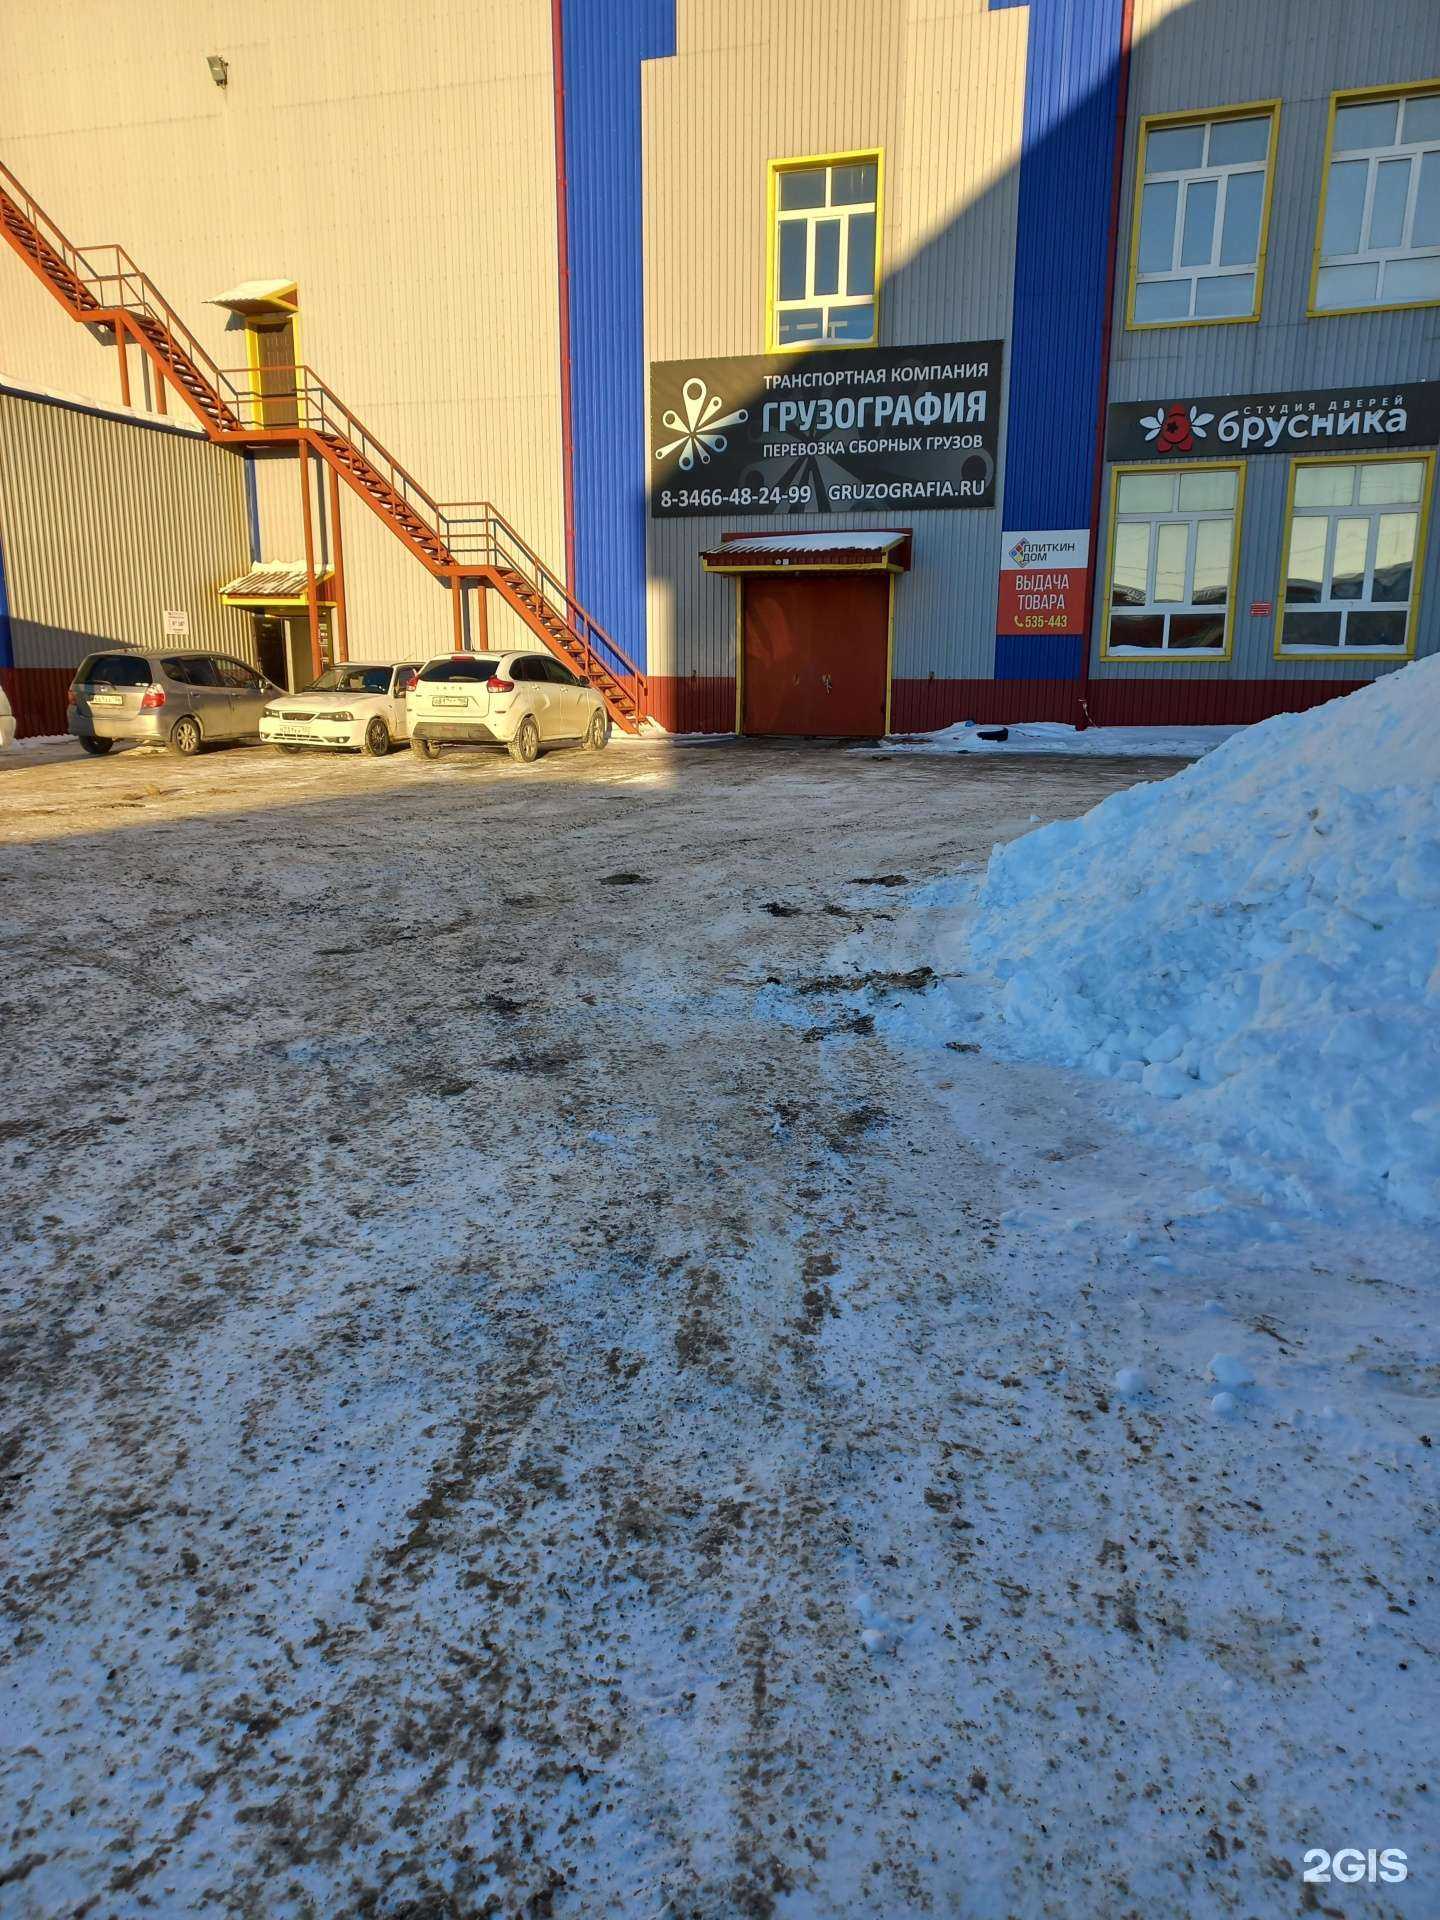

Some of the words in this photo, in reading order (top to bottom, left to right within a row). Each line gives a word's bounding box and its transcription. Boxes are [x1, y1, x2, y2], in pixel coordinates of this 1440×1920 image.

[763, 368, 887, 390] ТРАНСПОРТНАЯ
[891, 362, 989, 382] КОМПАНИЯ
[762, 390, 988, 433] ГРУЗОГРАФИЯ
[1243, 402, 1316, 415] СТУДИЯ
[1328, 395, 1404, 411] ДВЕРЕЙ
[1217, 407, 1408, 448] брусника
[763, 442, 846, 458] ПЕРЕВОЗКА
[849, 438, 922, 455] СБОРНЫХ
[926, 434, 984, 451] ГРУЗОВ
[660, 485, 812, 508] 8-3466-48-24-99
[828, 479, 986, 501] GRUZOGRAFIA.RU
[1023, 543, 1075, 553] ПЛИТКИН
[1023, 553, 1048, 562] ДОМ
[1015, 574, 1070, 592] ВЫДАЧА
[1017, 594, 1066, 610] ТОВАРА
[1025, 615, 1068, 628] 535-443
